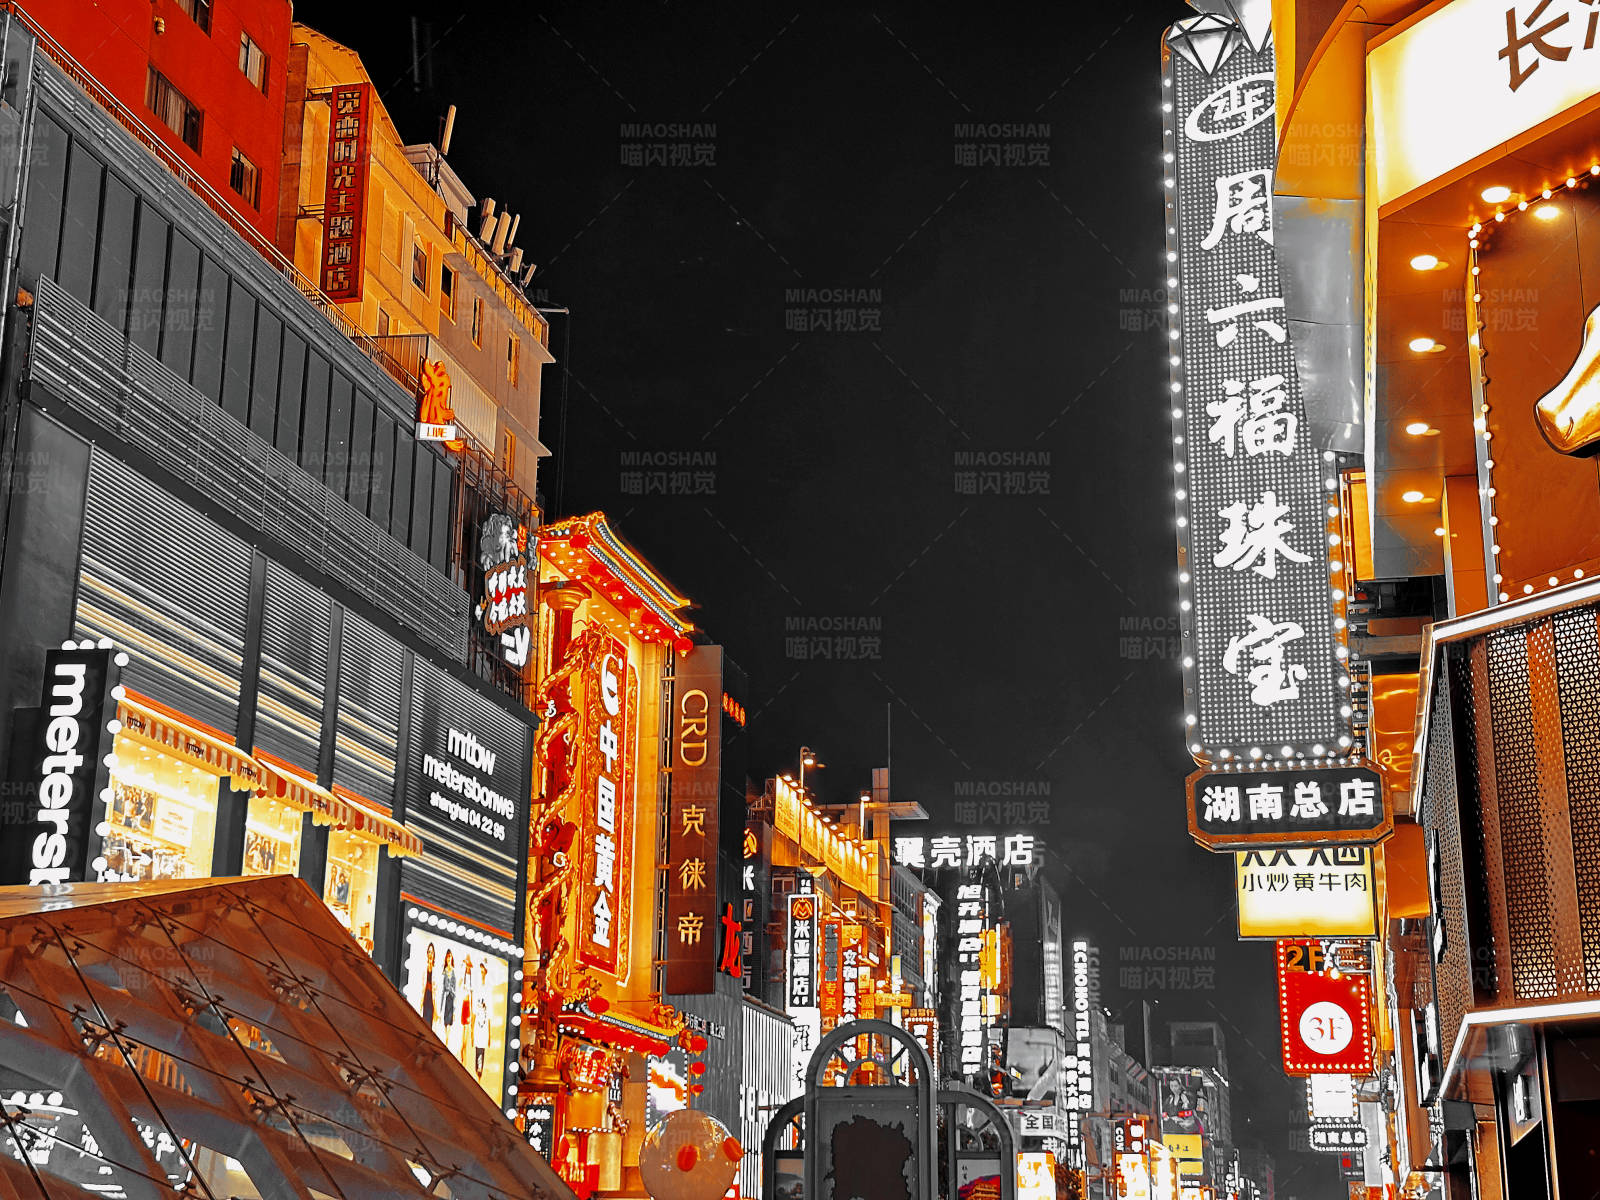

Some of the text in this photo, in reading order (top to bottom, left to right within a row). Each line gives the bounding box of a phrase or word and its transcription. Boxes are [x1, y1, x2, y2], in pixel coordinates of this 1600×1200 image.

[1201, 168, 1314, 707] 周六福珠宝
[680, 689, 709, 767] CRD
[422, 753, 515, 821] metersbonwe
[1202, 778, 1376, 822] 湖南总店
[469, 808, 482, 830] 04
[480, 817, 494, 837] 22
[493, 824, 506, 842] 95
[593, 720, 619, 949] 中国黄金
[677, 803, 707, 945] 克徕帝
[1241, 872, 1368, 892] 小炒黄牛肉
[792, 919, 811, 996] 米亚酒店
[1309, 1016, 1346, 1042] 3F
